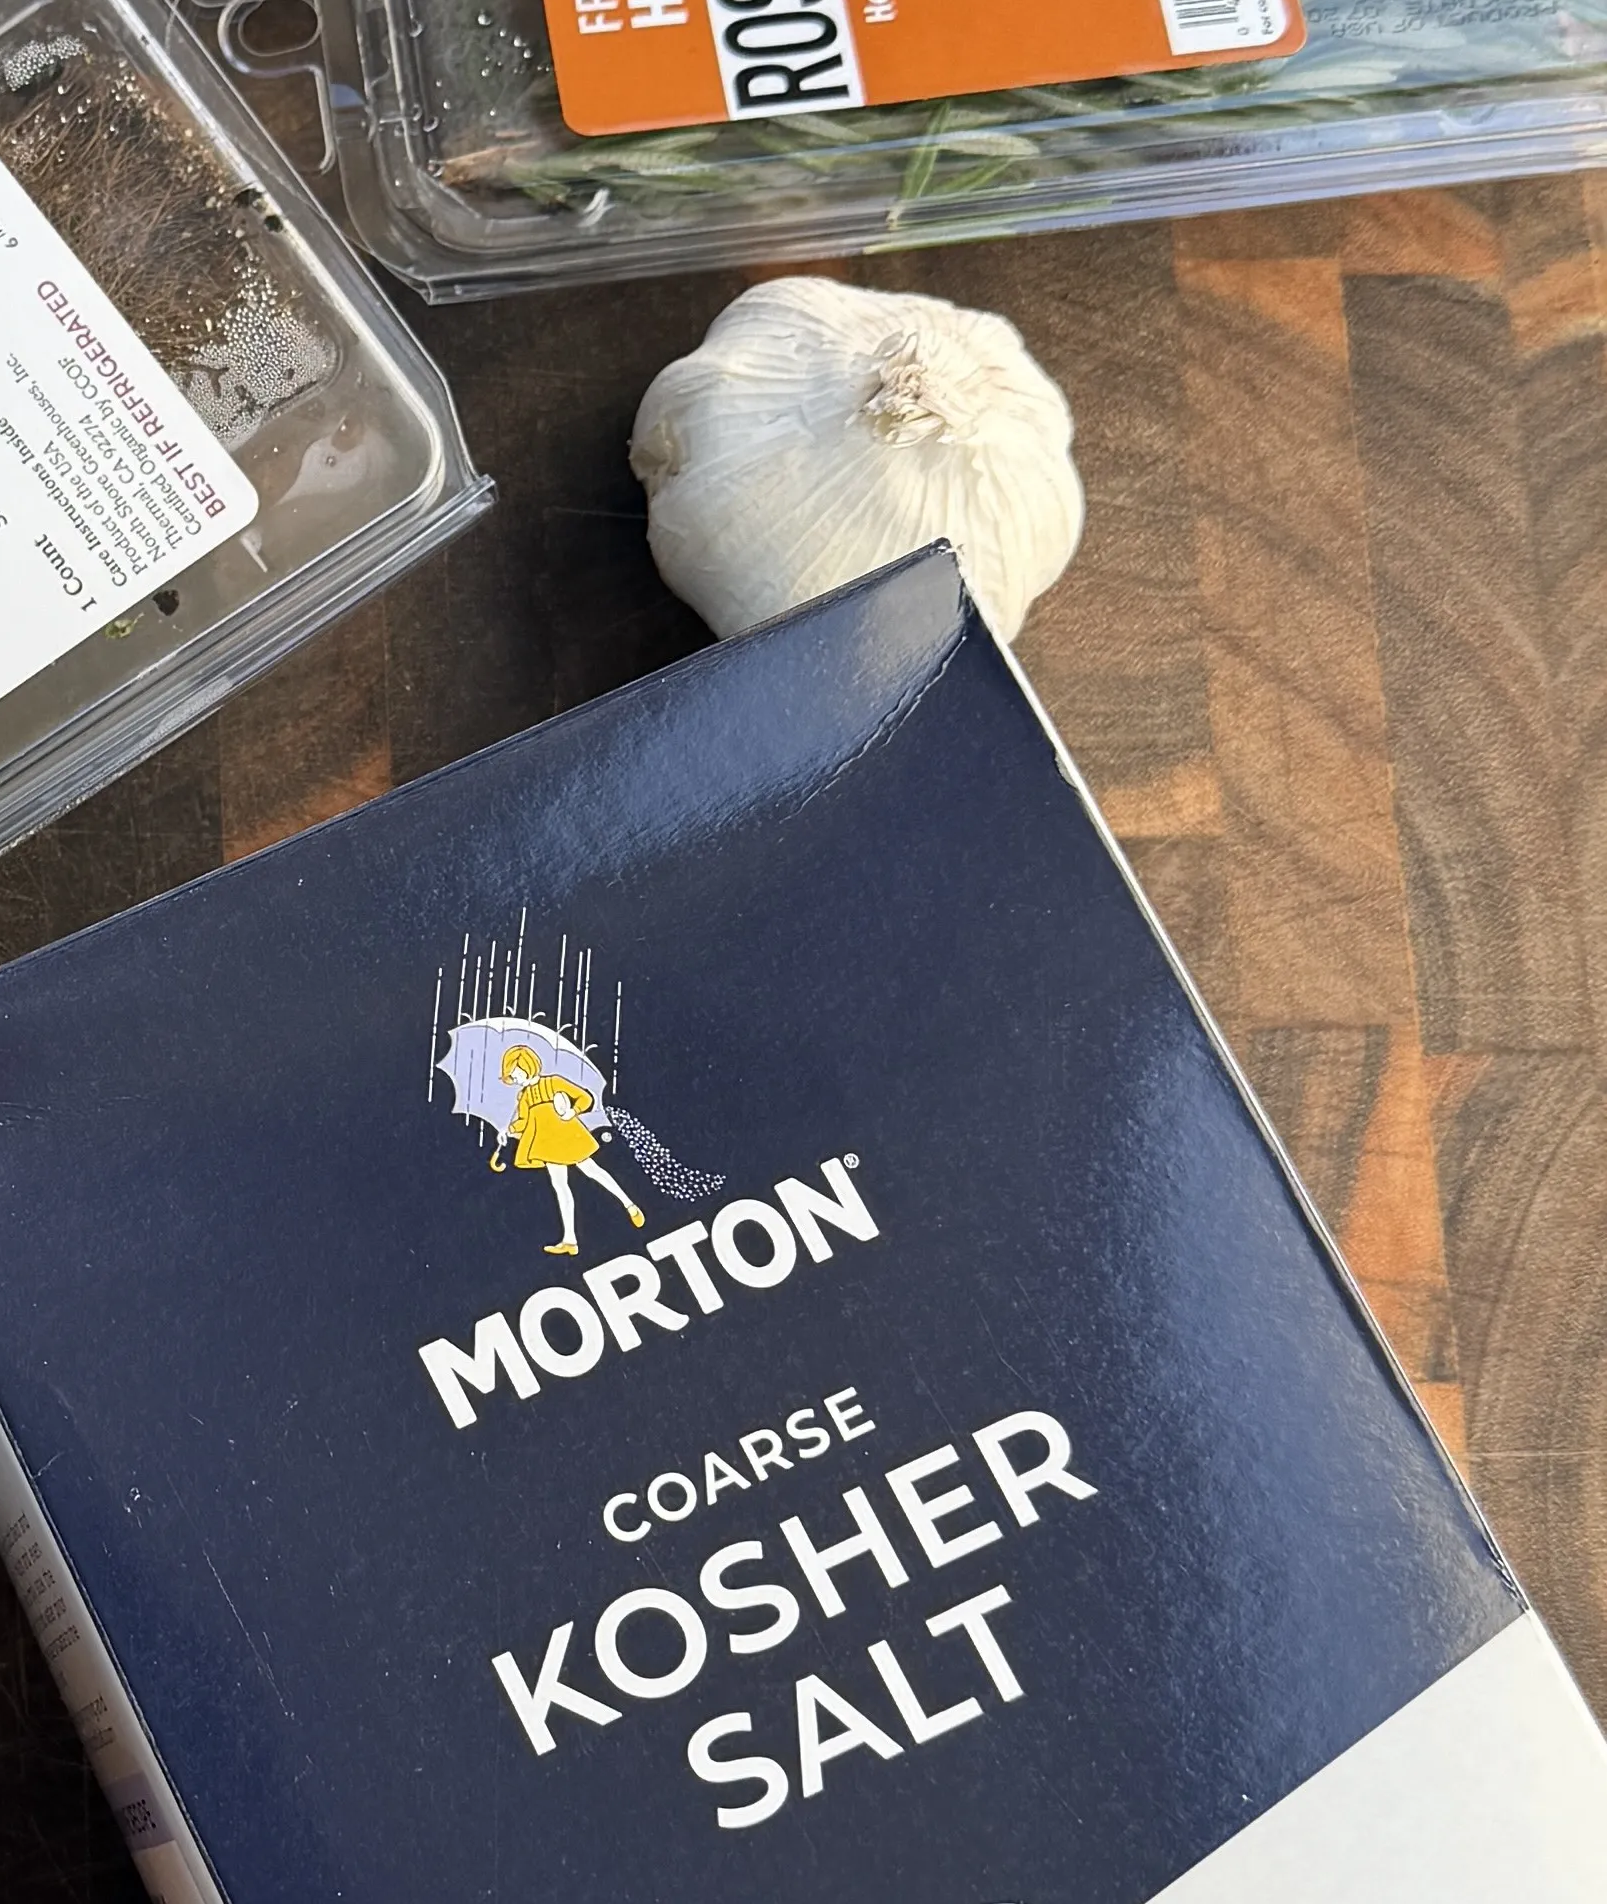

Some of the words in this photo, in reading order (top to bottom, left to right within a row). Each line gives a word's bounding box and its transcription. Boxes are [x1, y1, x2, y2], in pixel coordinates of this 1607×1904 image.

[1258, 14, 1274, 35] For
[5, 236, 18, 247] 6
[6, 352, 29, 383] Inc.
[37, 280, 164, 437] REFRIGERATED
[57, 357, 98, 399] CCOF
[27, 379, 98, 474] Greenhouses,
[94, 398, 114, 420] by
[43, 439, 72, 476] USA
[78, 413, 116, 459] 92274
[110, 416, 156, 474] Organic
[154, 439, 182, 461] IF
[69, 474, 92, 500] the
[112, 456, 134, 483] CA
[172, 462, 226, 517] BEST
[31, 462, 101, 550] Instructions
[83, 499, 104, 515] of
[97, 473, 133, 518] Shore
[132, 481, 183, 549] Thermal,
[149, 472, 201, 535] Certified
[101, 515, 148, 574] Product
[129, 516, 166, 562] North
[34, 533, 82, 595] Count
[98, 549, 127, 586] Care
[81, 596, 96, 610] 1
[603, 1386, 876, 1542] COARSE
[491, 1410, 1099, 1755] KOSHER
[687, 1584, 1024, 1828] SALT
